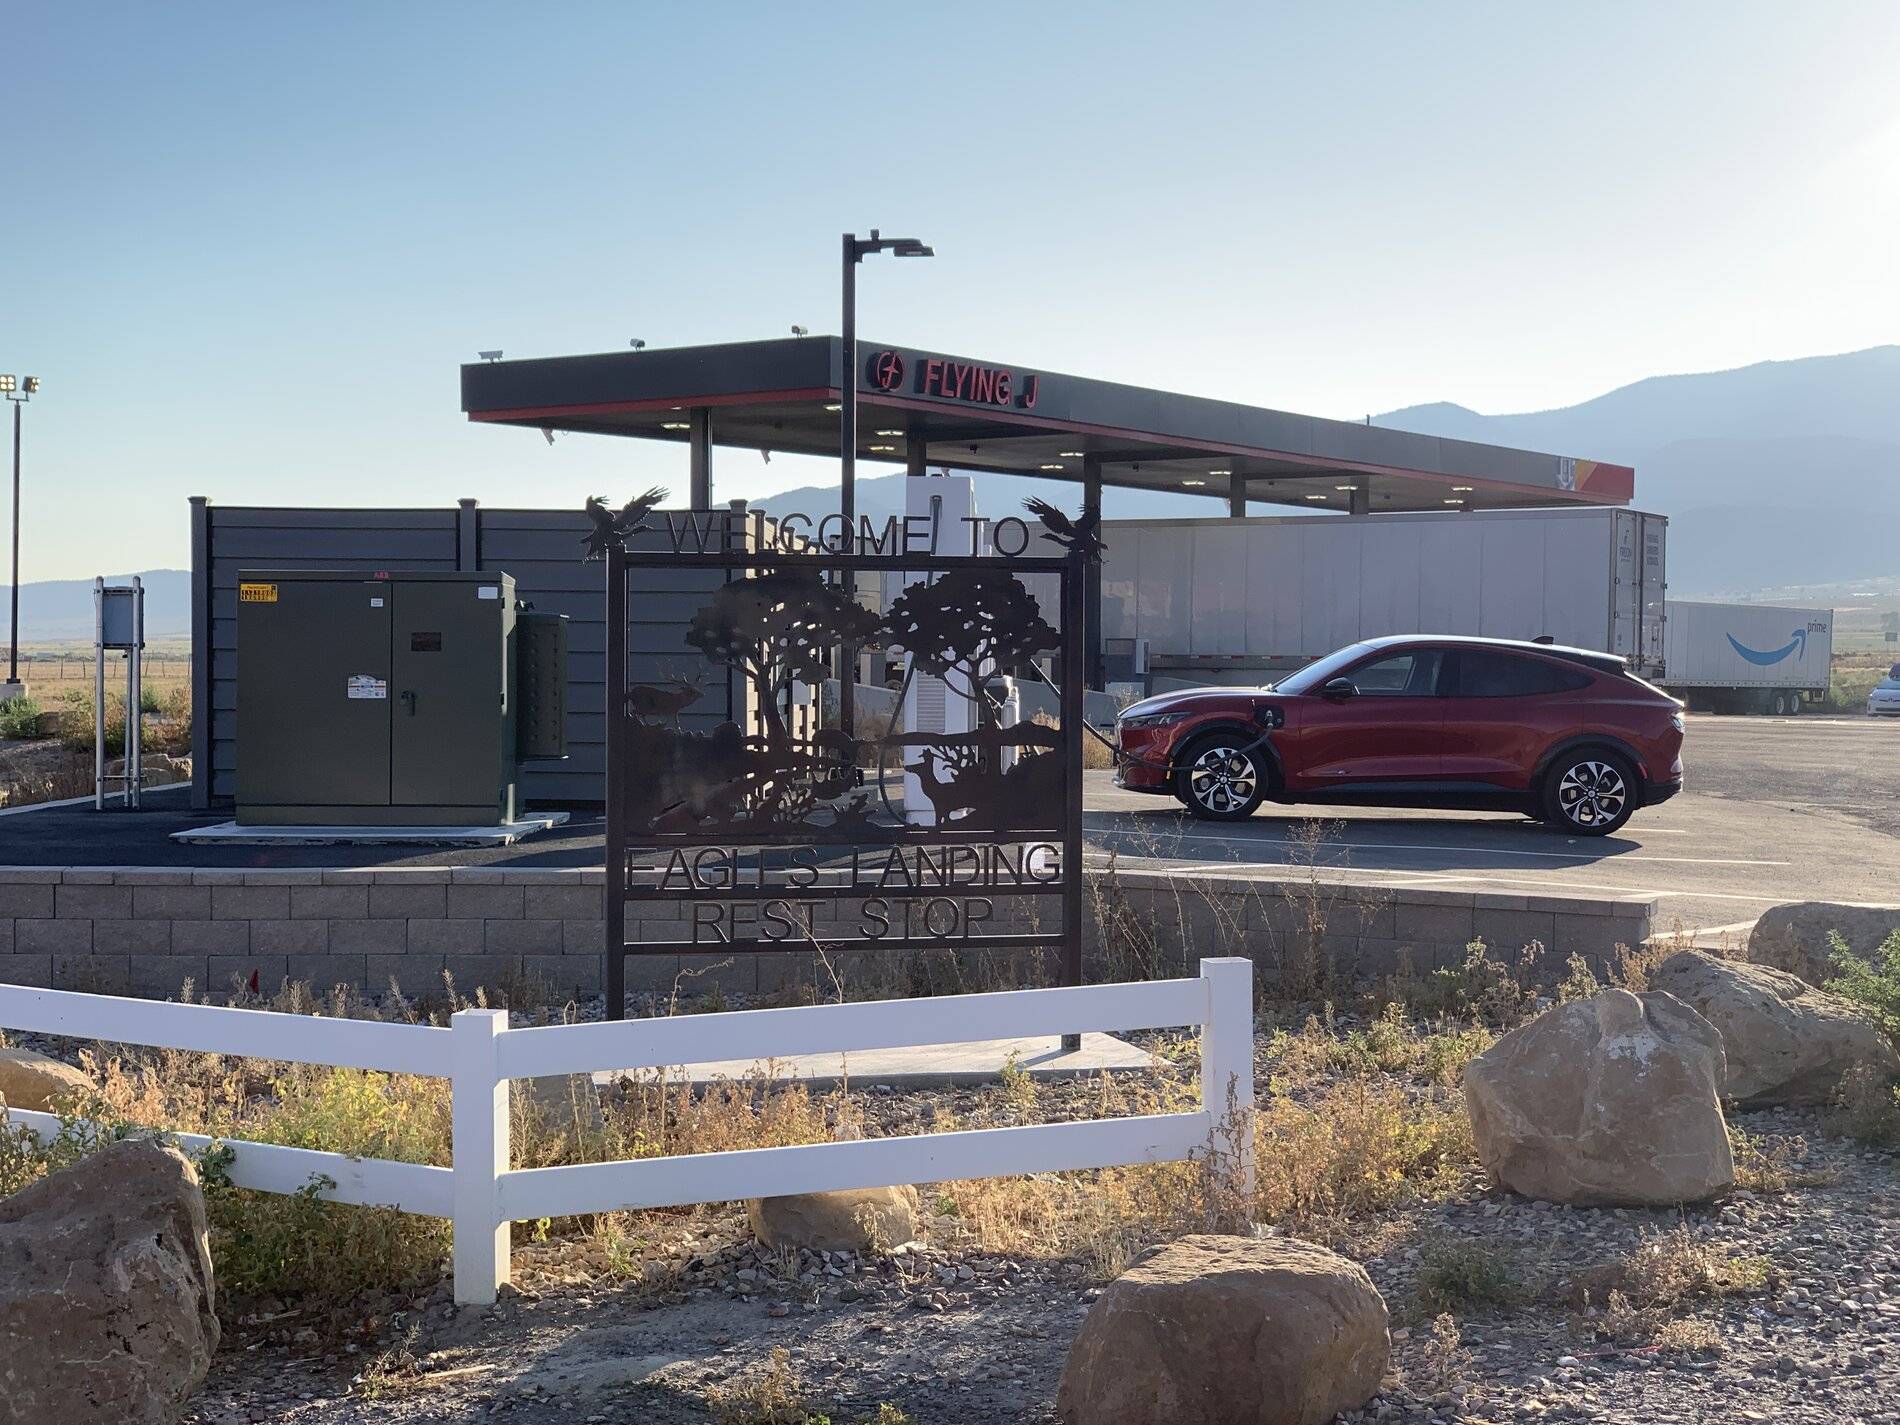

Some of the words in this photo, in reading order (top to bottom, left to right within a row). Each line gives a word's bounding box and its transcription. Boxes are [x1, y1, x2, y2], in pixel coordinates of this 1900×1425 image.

[921, 359, 1012, 405] FLYING
[1020, 375, 1040, 409] J
[664, 512, 931, 555] WELCOME
[960, 516, 1030, 557] TO
[1807, 619, 1827, 634] prime
[626, 846, 820, 888] EAGLES
[852, 844, 1061, 886] LANDING
[692, 900, 827, 942] REST
[858, 896, 993, 940] STOP
